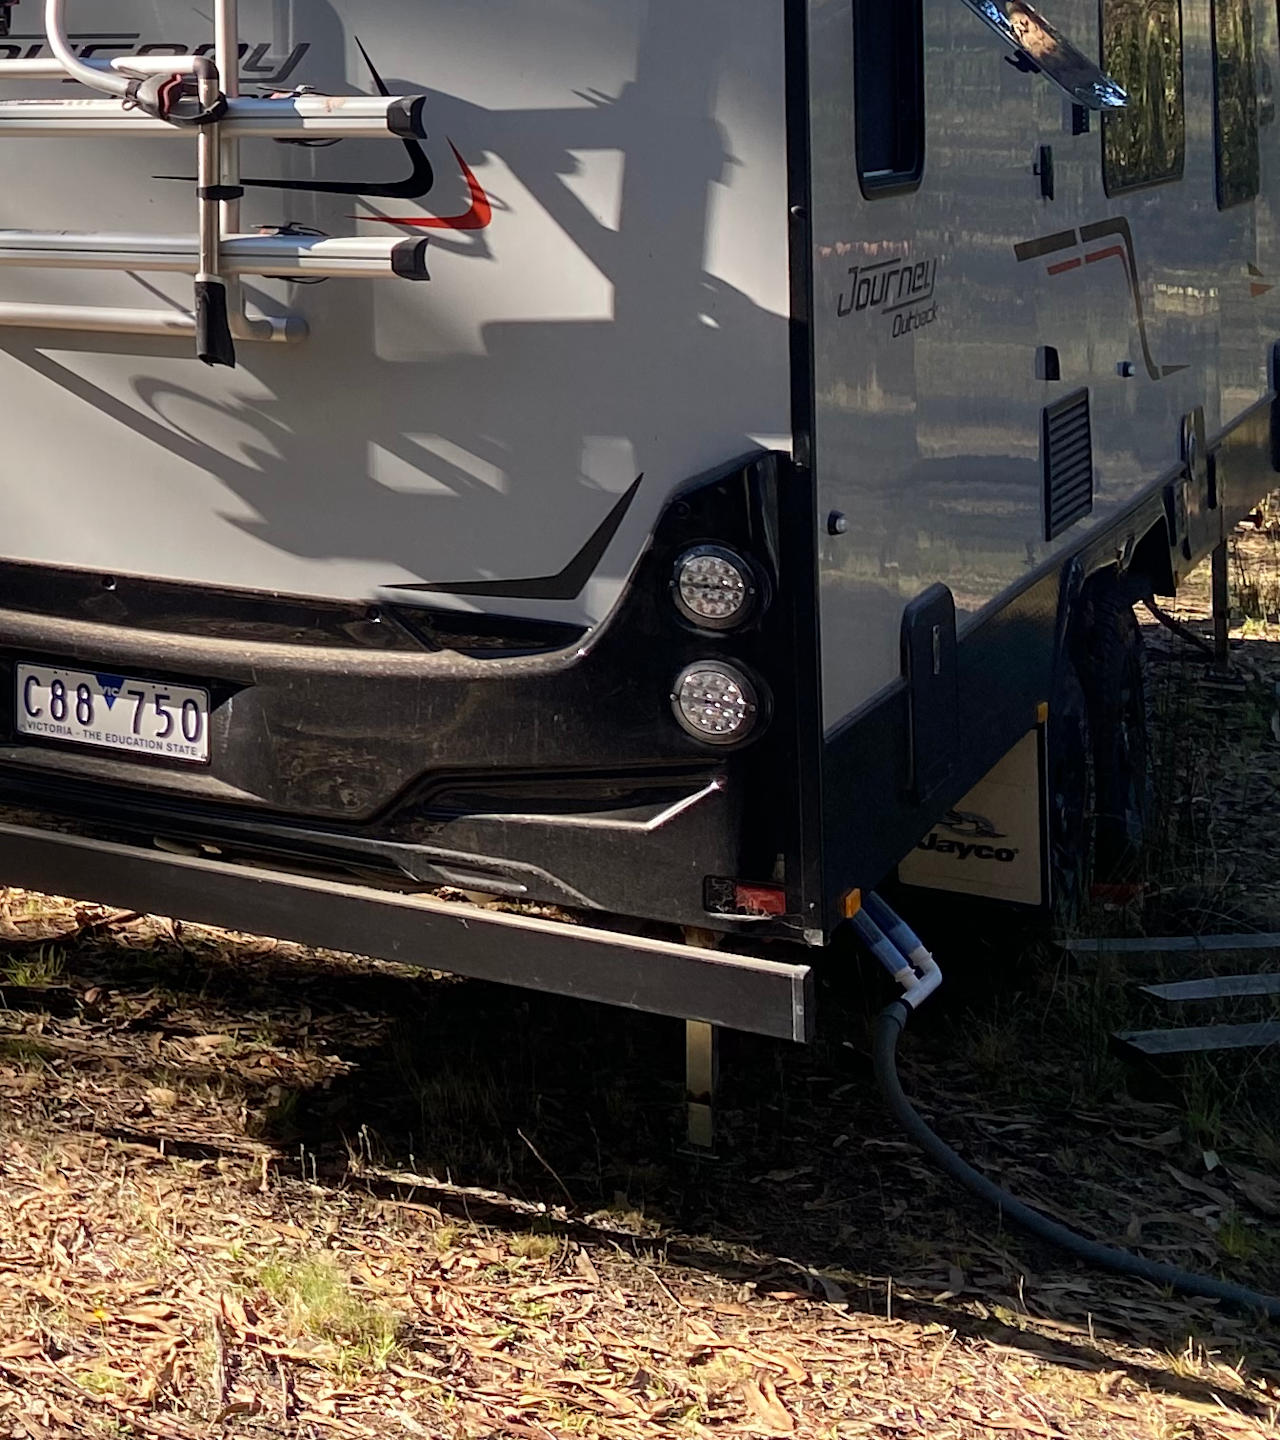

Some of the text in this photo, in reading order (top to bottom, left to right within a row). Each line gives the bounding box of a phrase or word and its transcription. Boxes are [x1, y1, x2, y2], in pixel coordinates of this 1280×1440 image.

[837, 257, 937, 318] Journey
[23, 675, 202, 743] C88 750
[102, 685, 121, 697] VIC
[27, 720, 73, 736] VICTORIA
[83, 729, 102, 741] THE
[105, 734, 163, 751] EDUCATION
[166, 743, 198, 756] STATE
[917, 833, 1017, 861] Jayco
